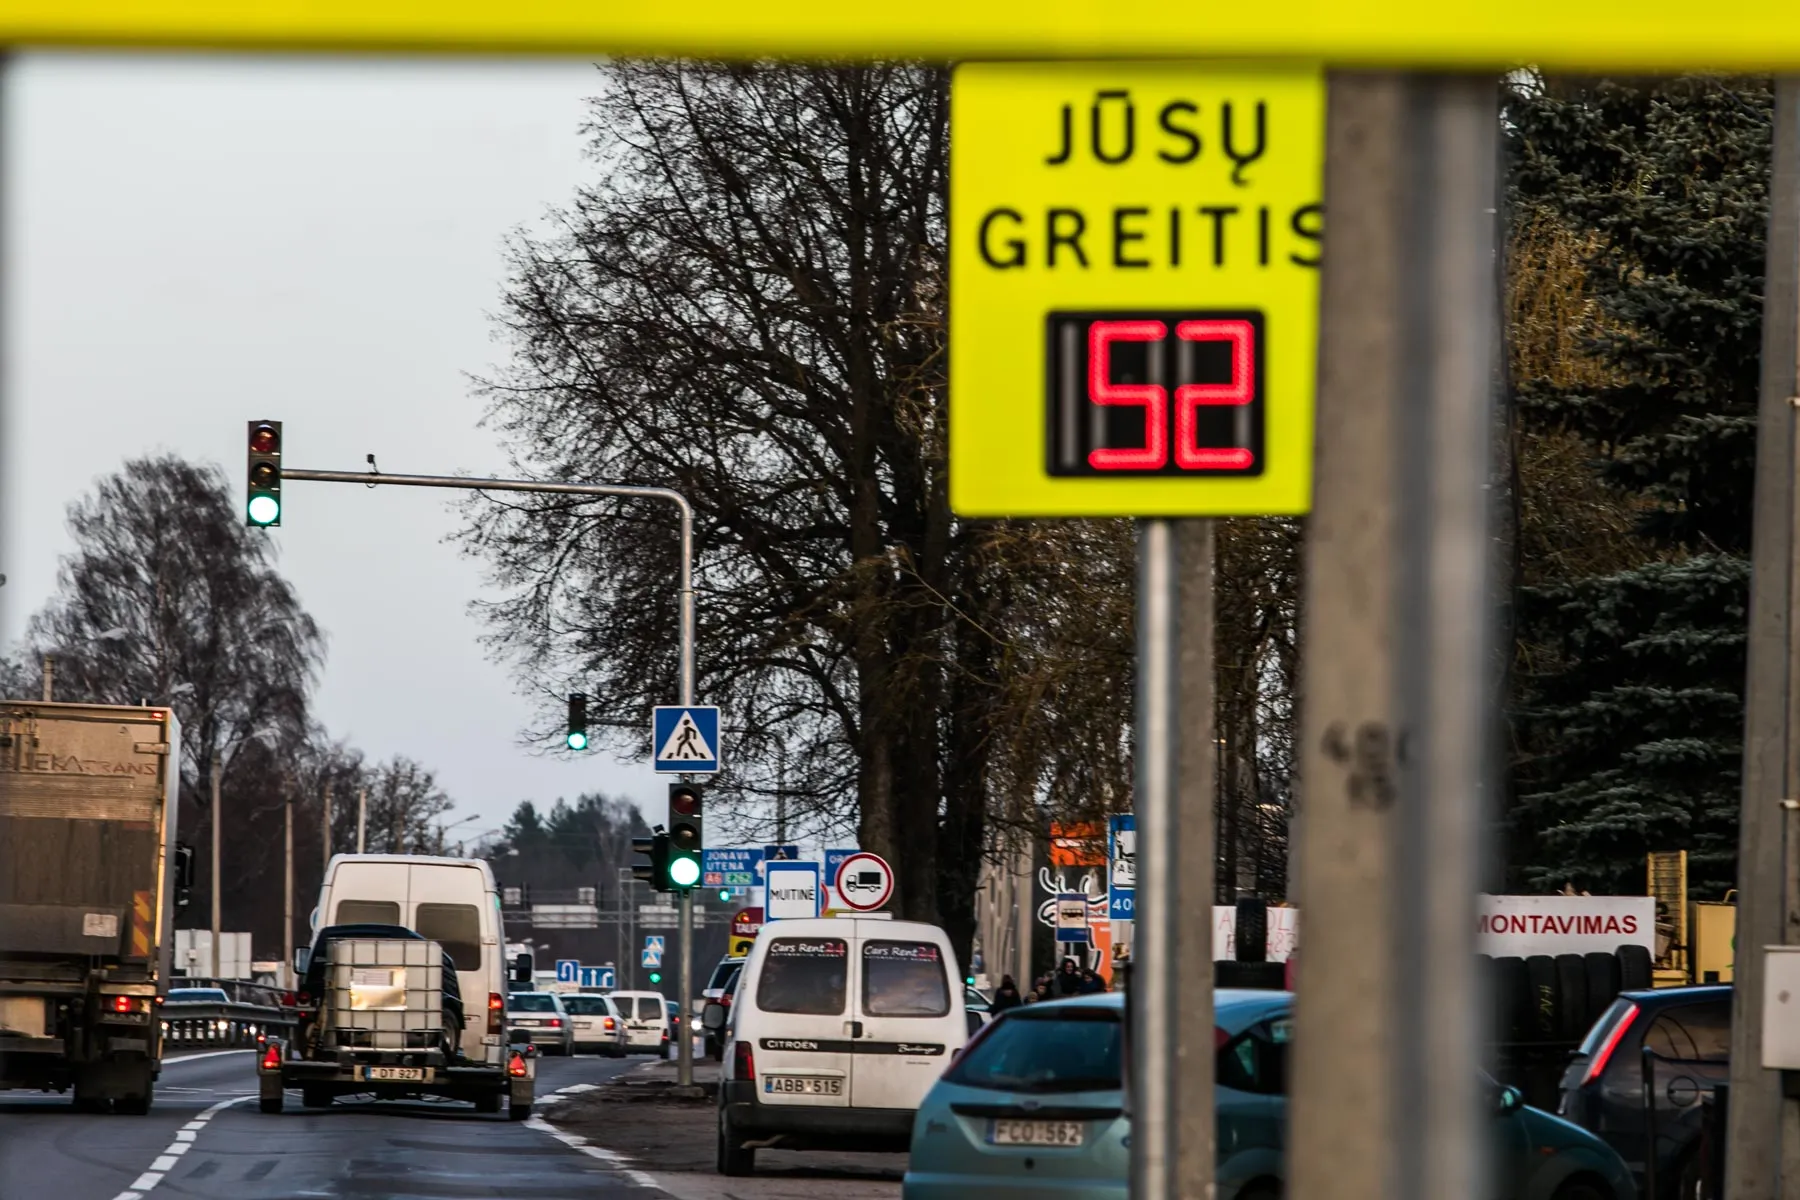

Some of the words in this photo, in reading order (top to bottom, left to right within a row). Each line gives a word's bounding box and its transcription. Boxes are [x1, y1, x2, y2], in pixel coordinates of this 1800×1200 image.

[1044, 89, 1268, 187] JŪSŲ
[976, 205, 1326, 270] GREITIS
[1088, 320, 1255, 470] 52
[707, 851, 750, 860] JONAVA
[706, 861, 744, 871] UTENA
[770, 886, 815, 900] MUITINĖ
[1112, 898, 1135, 911] 40
[735, 922, 762, 933] TAUP
[771, 942, 796, 952] Cars
[864, 945, 888, 955] Cars
[399, 1068, 417, 1079] 927
[775, 1079, 804, 1092] ABB
[813, 1080, 840, 1094] 515
[996, 1121, 1033, 1141] FCO
[1046, 1122, 1079, 1143] 562
